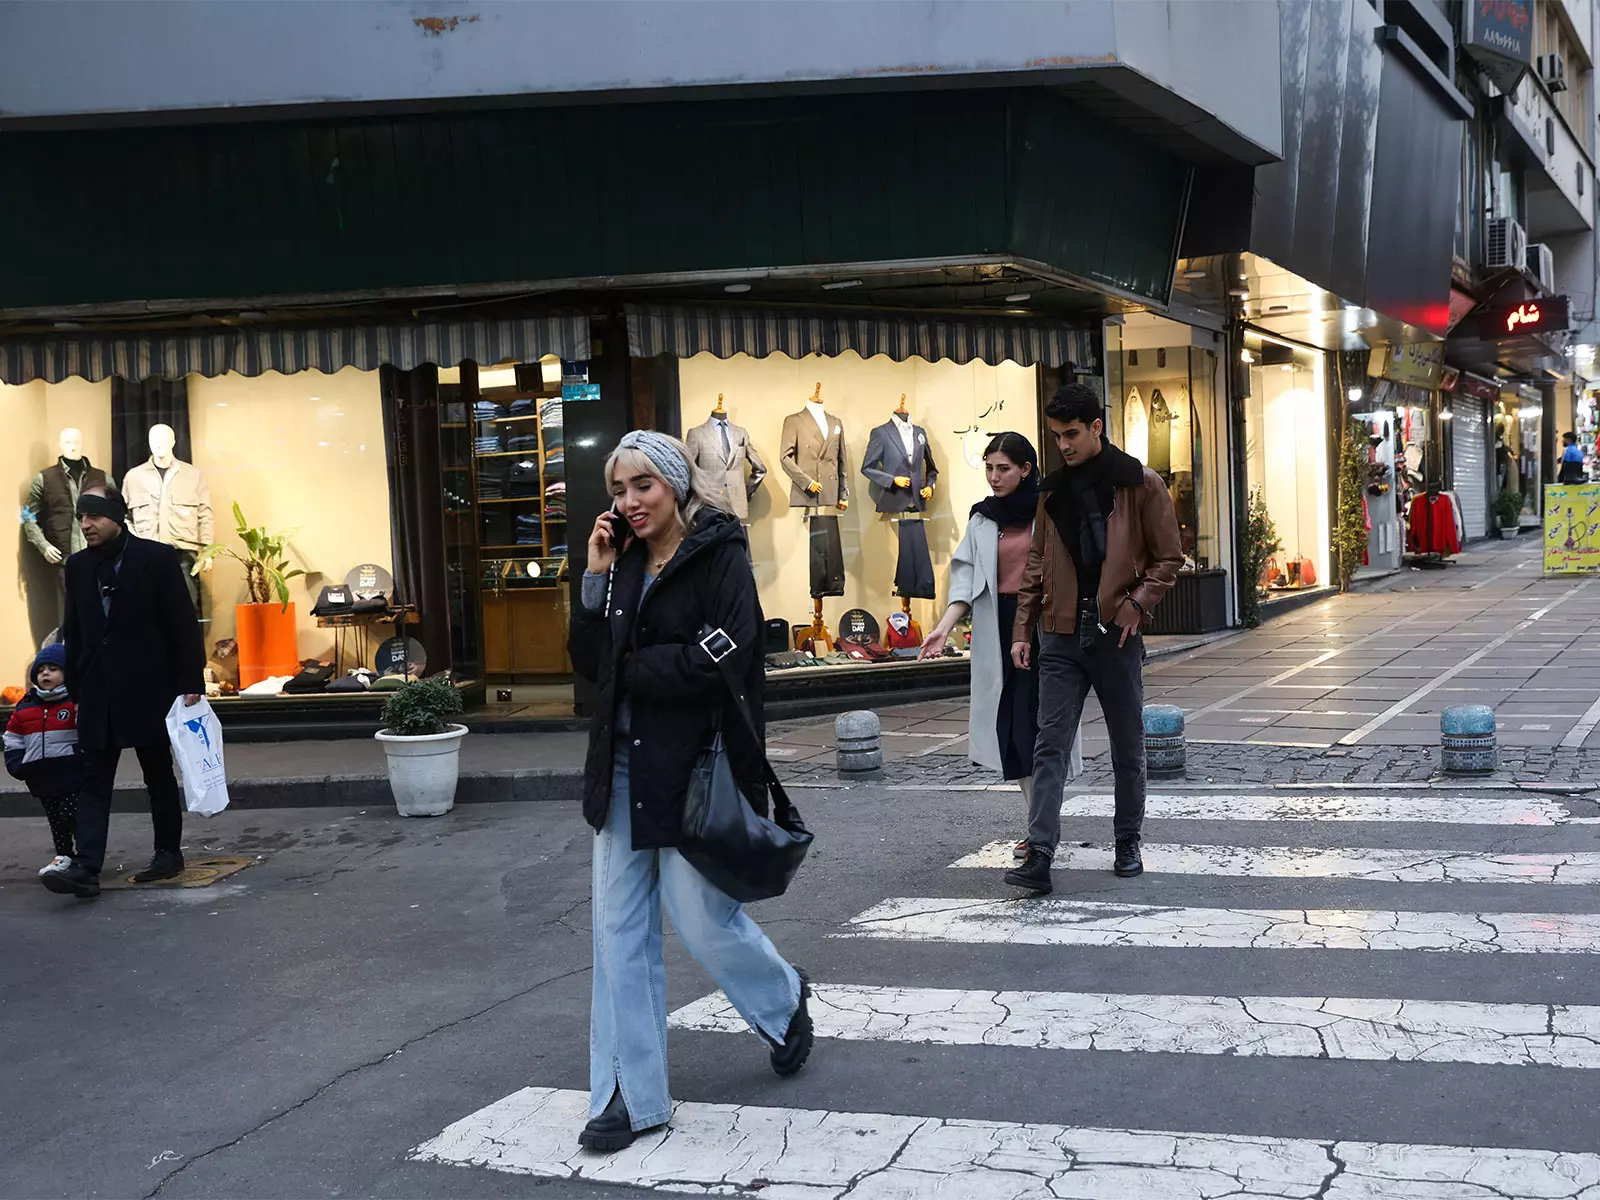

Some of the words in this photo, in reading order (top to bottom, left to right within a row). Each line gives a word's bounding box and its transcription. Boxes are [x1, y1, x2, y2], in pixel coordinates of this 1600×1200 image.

[1507, 304, 1540, 332] شام
[360, 579, 377, 588] DAY
[60, 711, 67, 720] 7
